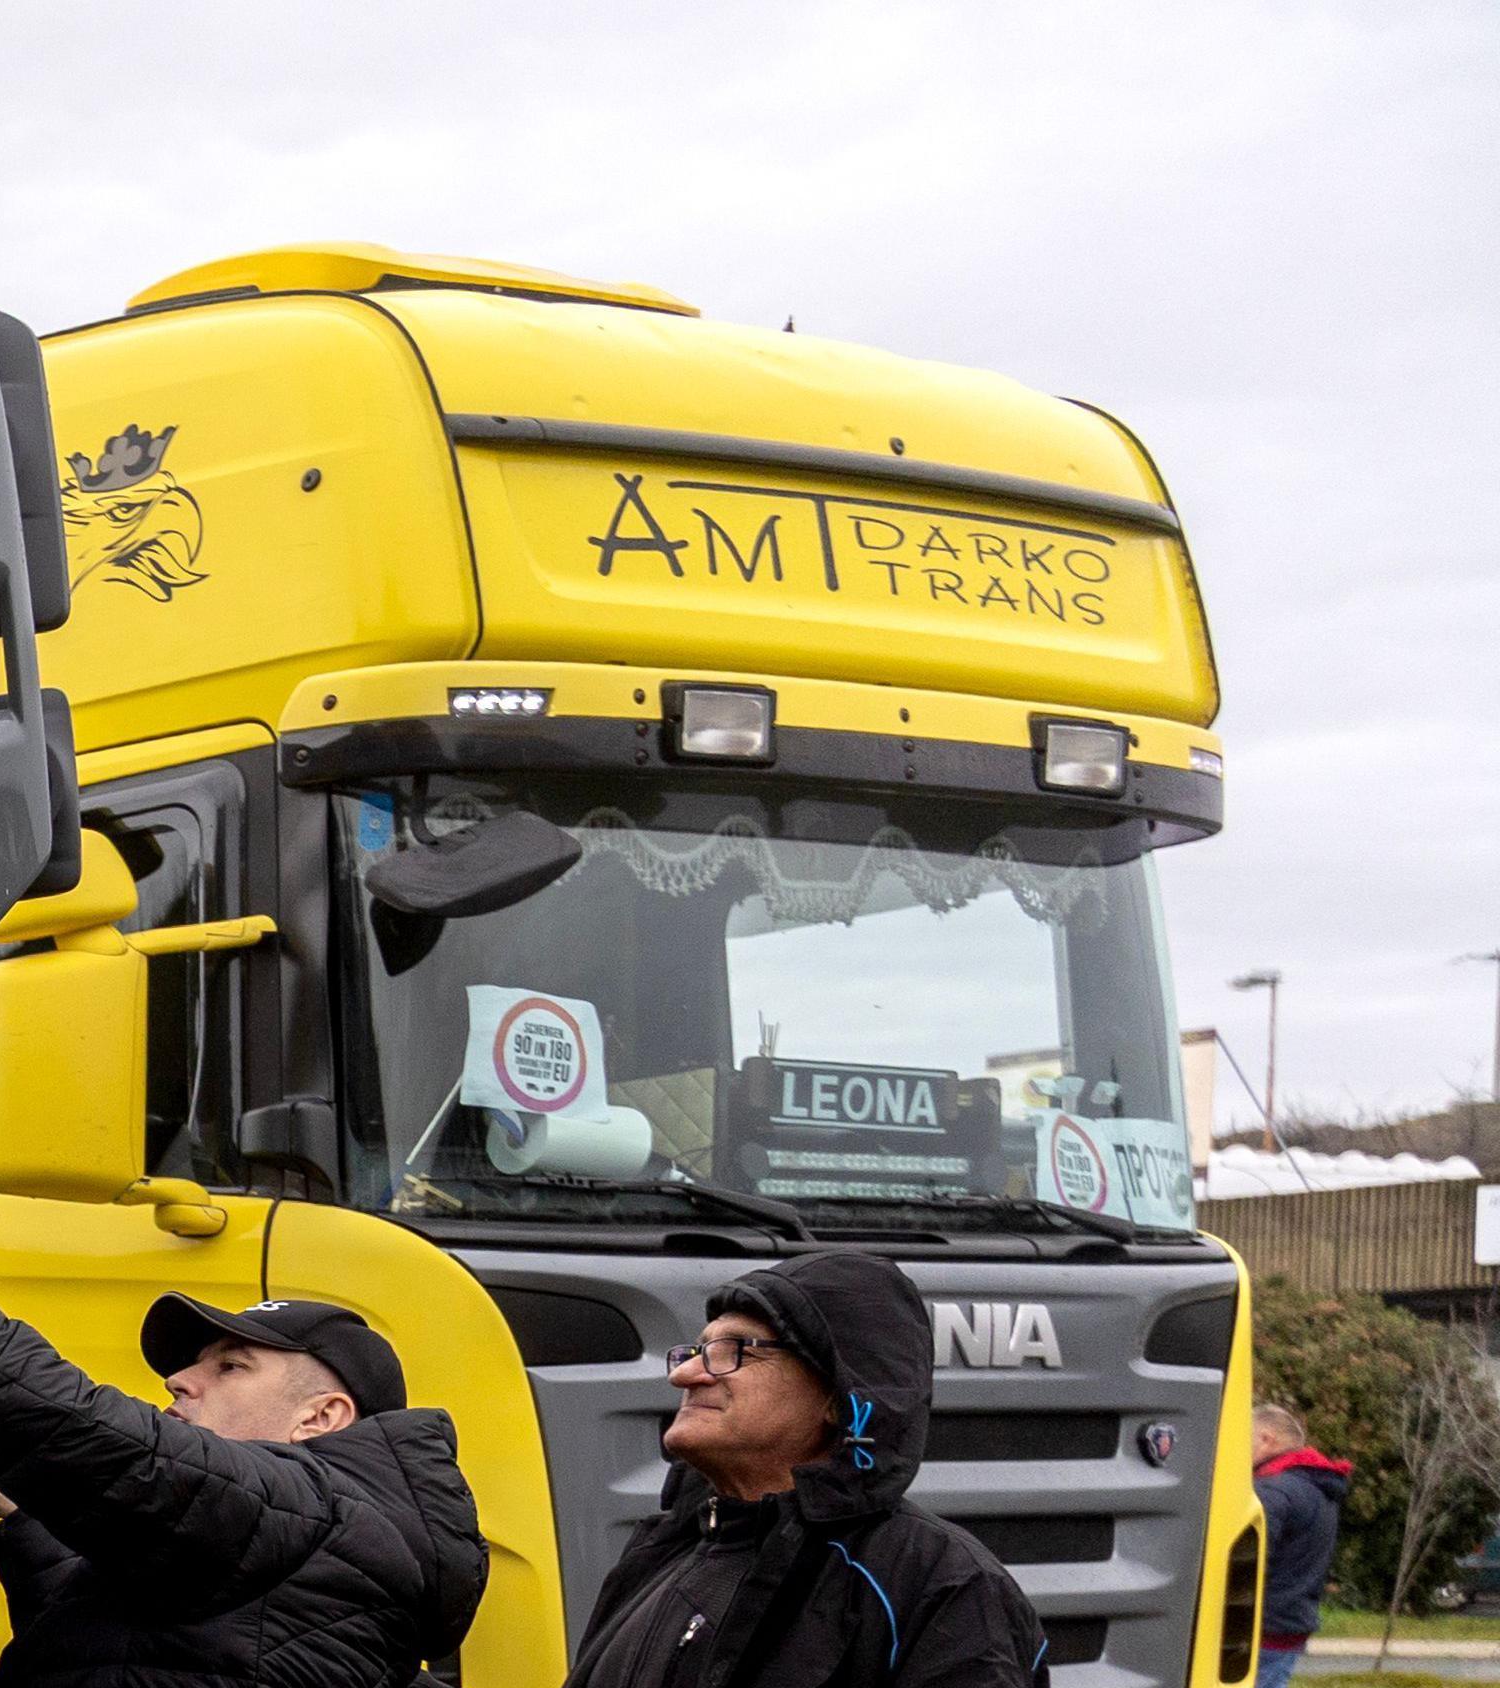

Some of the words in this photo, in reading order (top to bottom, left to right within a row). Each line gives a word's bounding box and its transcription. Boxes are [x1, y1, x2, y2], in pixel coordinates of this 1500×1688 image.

[847, 515, 1111, 583] DARKO
[867, 560, 1106, 625] TRANS
[514, 1034, 532, 1054] 90
[549, 1040, 572, 1061] 180
[553, 1063, 570, 1082] EU
[781, 1071, 939, 1126] LEONA
